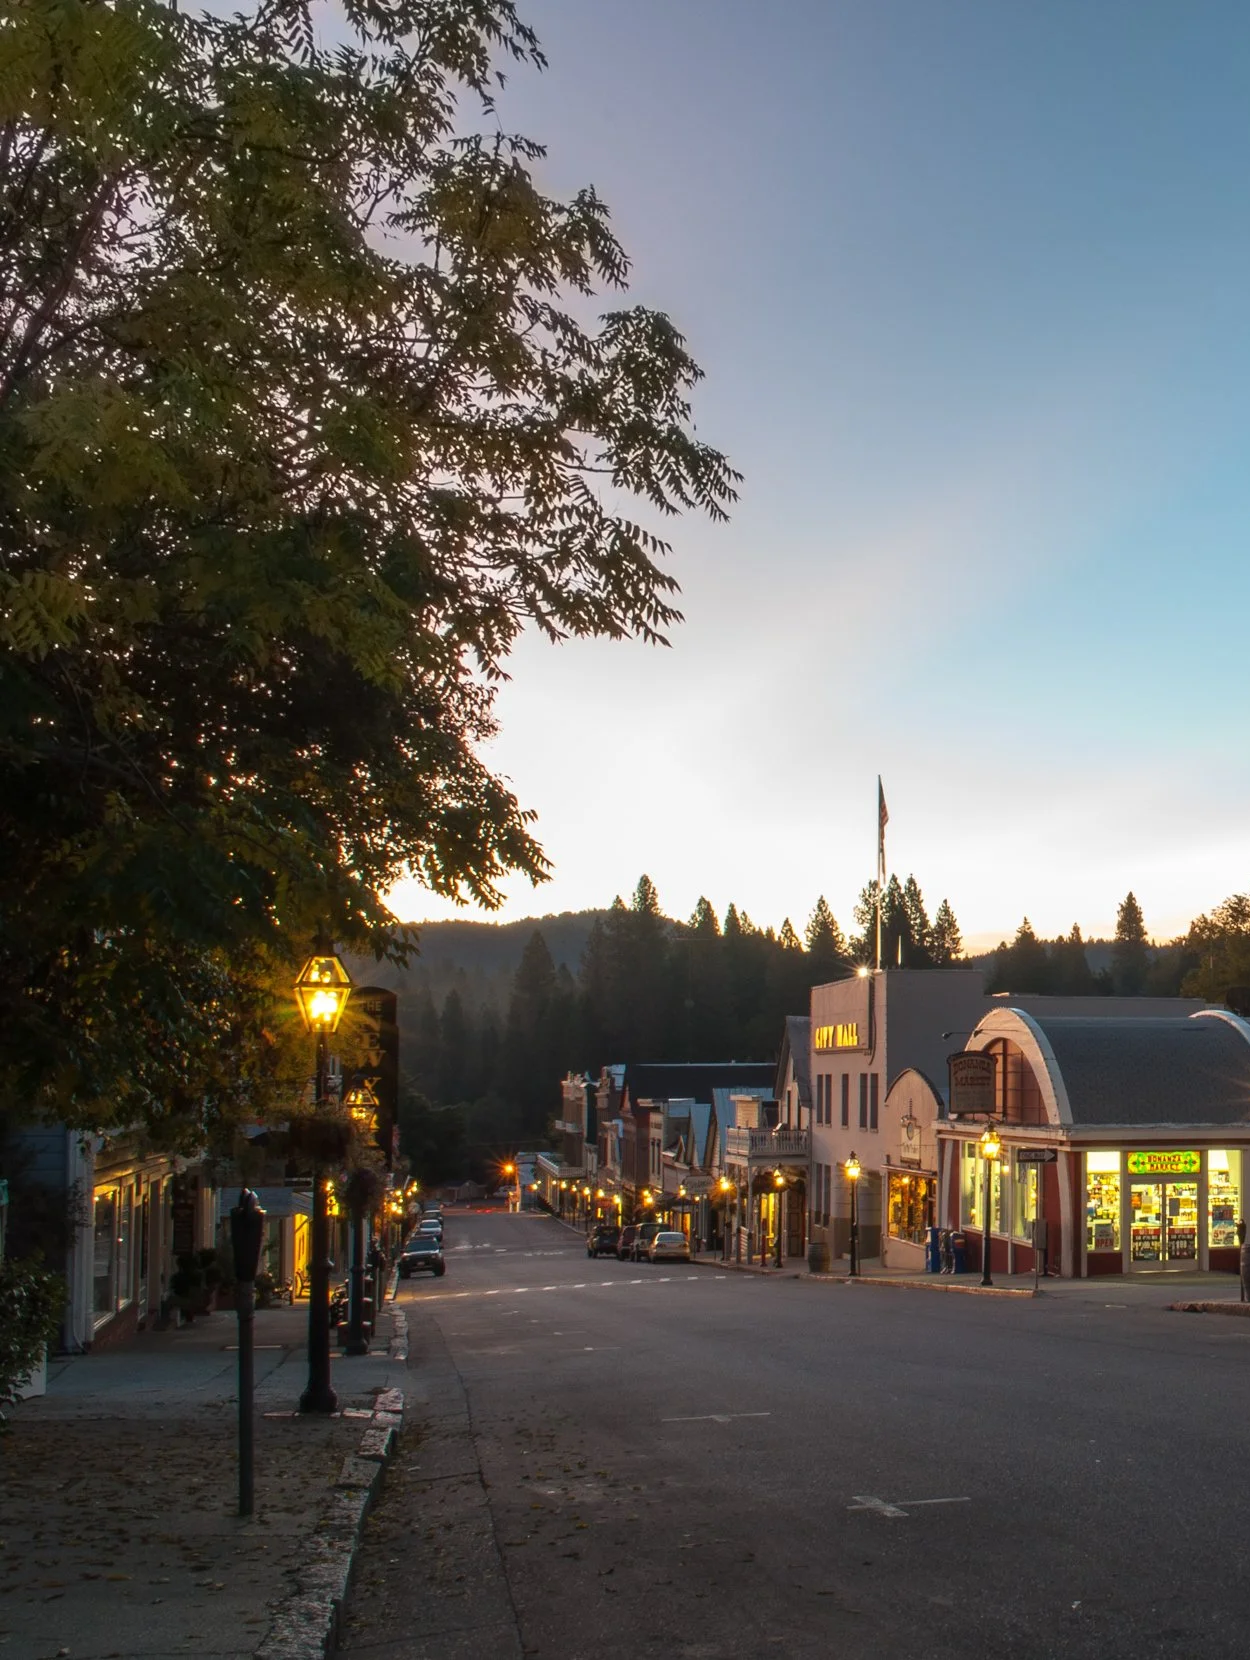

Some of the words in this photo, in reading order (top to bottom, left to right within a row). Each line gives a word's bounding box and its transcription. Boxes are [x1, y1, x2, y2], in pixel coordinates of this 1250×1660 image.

[815, 1025, 835, 1049] CITY
[836, 1022, 858, 1047] HALL
[1147, 1155, 1182, 1163] BONANZA
[1149, 1163, 1180, 1171] MARKET
